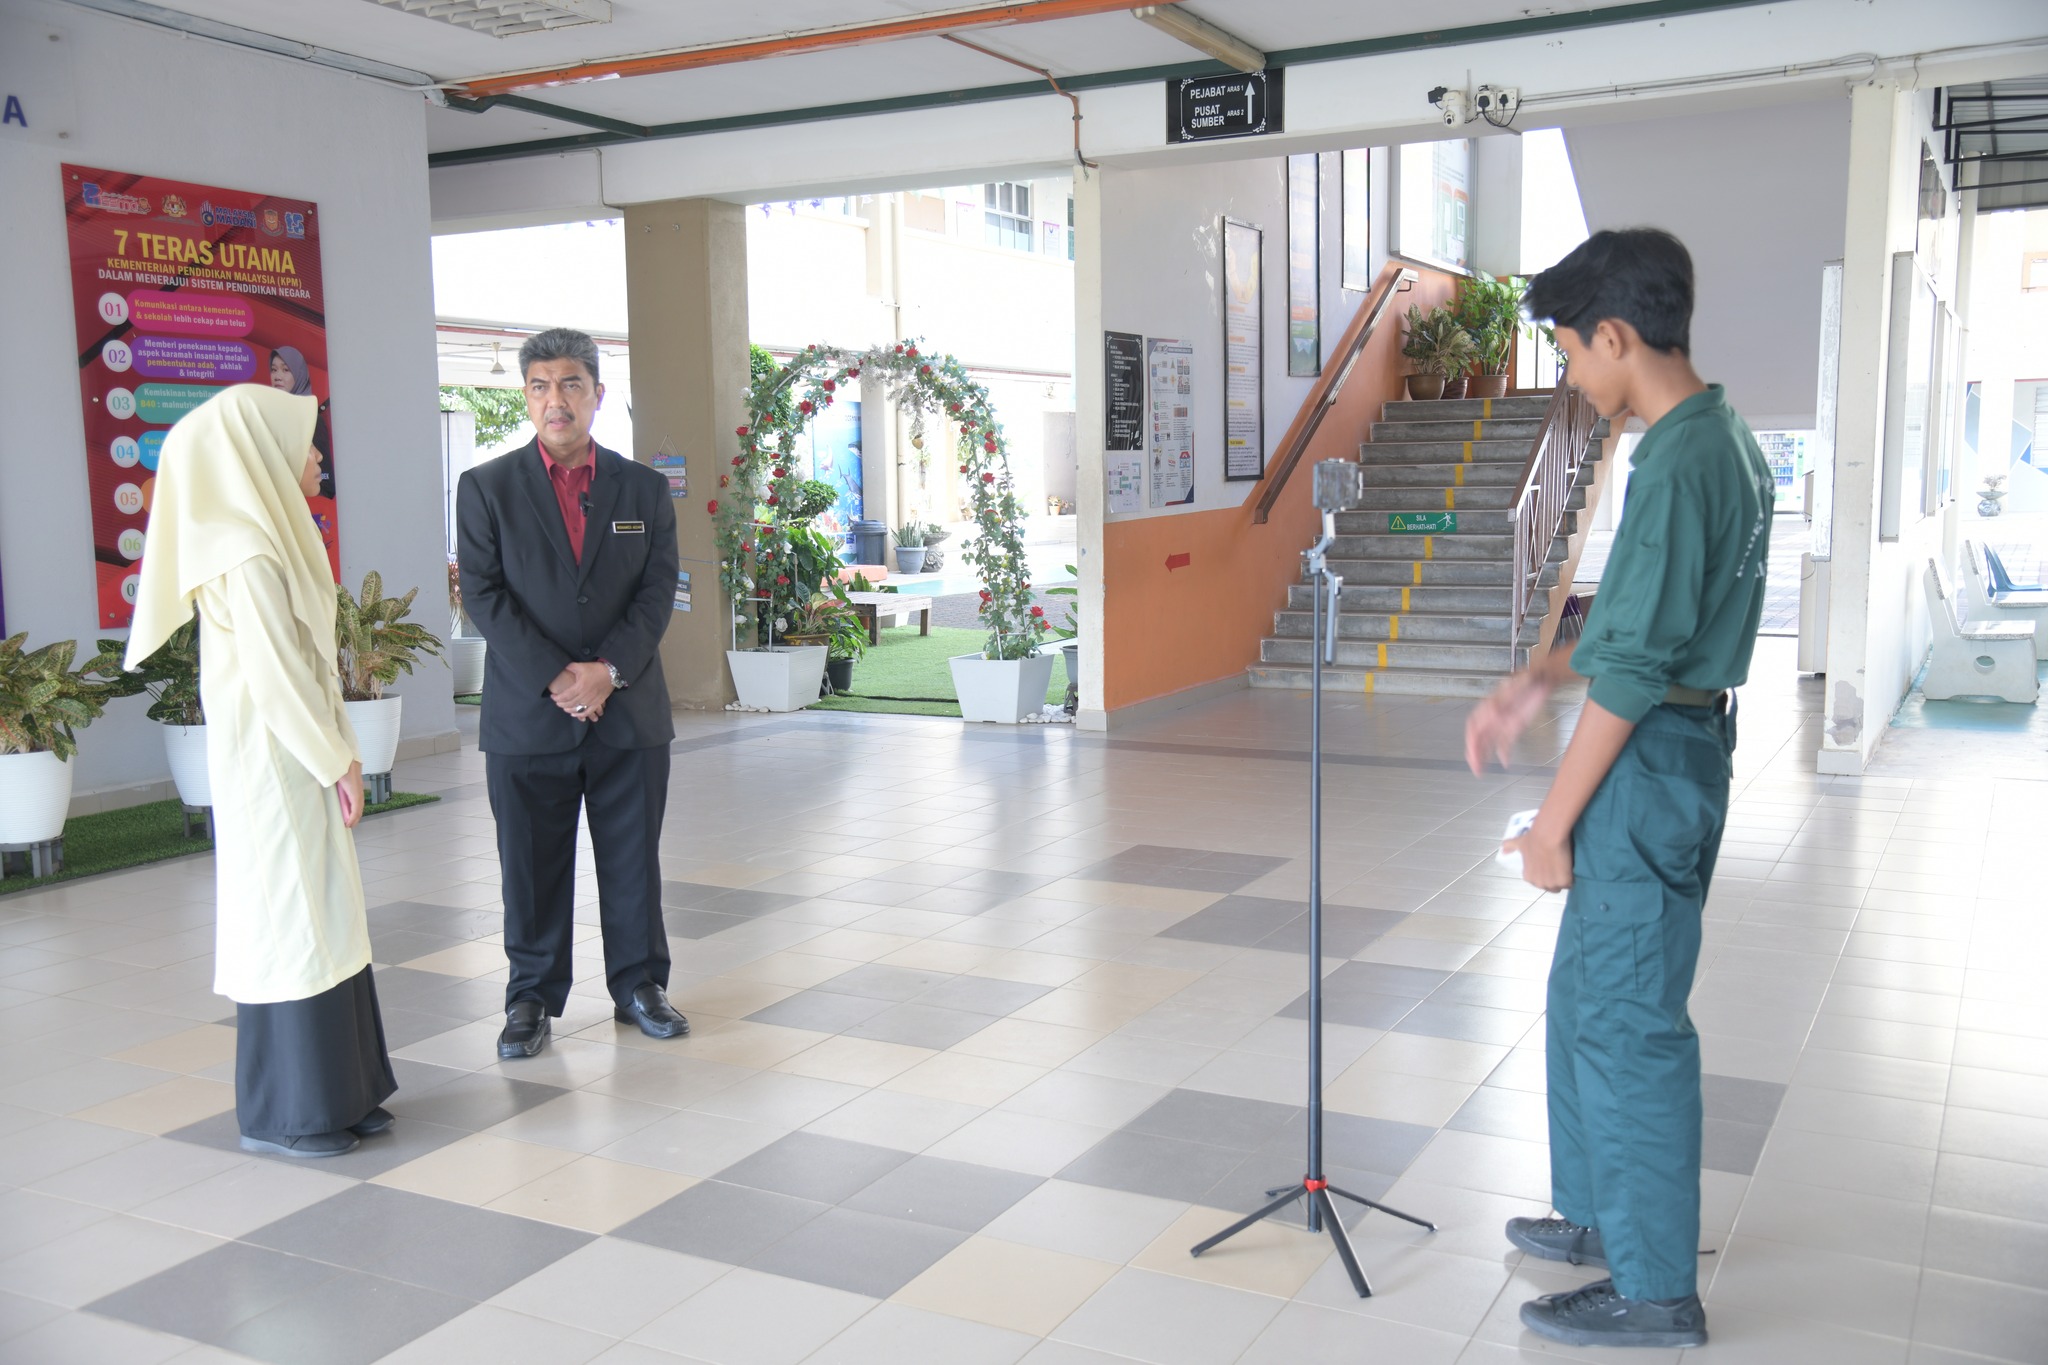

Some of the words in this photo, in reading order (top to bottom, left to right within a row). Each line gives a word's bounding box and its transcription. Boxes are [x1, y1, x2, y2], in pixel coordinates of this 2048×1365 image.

[1190, 86, 1226, 100] PEJABAT
[1227, 85, 1240, 93] ARAS
[1194, 104, 1220, 117] PUSAT
[1191, 115, 1225, 128] SUMBER
[215, 207, 255, 219] MALAYSIA
[215, 214, 257, 228] MADANI
[114, 229, 128, 256] 7
[137, 232, 214, 266] TERAS
[219, 242, 297, 275] UTAMA
[107, 257, 175, 274] KEMENTERIAN
[177, 265, 232, 280] PENDIDIKAN
[234, 271, 276, 285] MALAYSIA
[277, 276, 303, 290] (KPM)
[98, 268, 133, 282] DALAM
[135, 271, 189, 287] MENERAJUI
[191, 278, 224, 291] SISTEM
[226, 282, 277, 296] PENDIDIKAN
[279, 286, 311, 299] NEGARA
[104, 301, 122, 317] 01
[134, 299, 177, 310] Komunikasi
[179, 302, 202, 312] antara
[203, 304, 246, 316] kementerian
[136, 311, 142, 320] &
[144, 312, 172, 322] sekolah
[173, 314, 192, 323] lebih
[193, 317, 214, 326] cekap
[215, 318, 228, 326] dan
[229, 319, 246, 328] telus
[144, 339, 177, 349] Memberi
[178, 342, 216, 352] penekanan
[217, 344, 243, 353] kepada
[108, 348, 127, 364] 02
[137, 348, 160, 358] aspek
[161, 350, 193, 359] karamah
[194, 351, 223, 361] insaniah
[224, 353, 250, 363] melalui
[147, 358, 196, 368] pembentukan
[197, 361, 217, 370] adab,
[219, 362, 243, 371] akhlak
[179, 368, 185, 377] &
[186, 369, 215, 379] integriti
[143, 388, 186, 398] Kemiskinan
[112, 395, 130, 411] 03
[140, 400, 156, 409] B40
[116, 445, 134, 459] 04
[120, 491, 138, 506] 05
[1406, 523, 1437, 531] BERHATI-HATI
[123, 537, 141, 552] 06
[126, 583, 140, 597] 0
